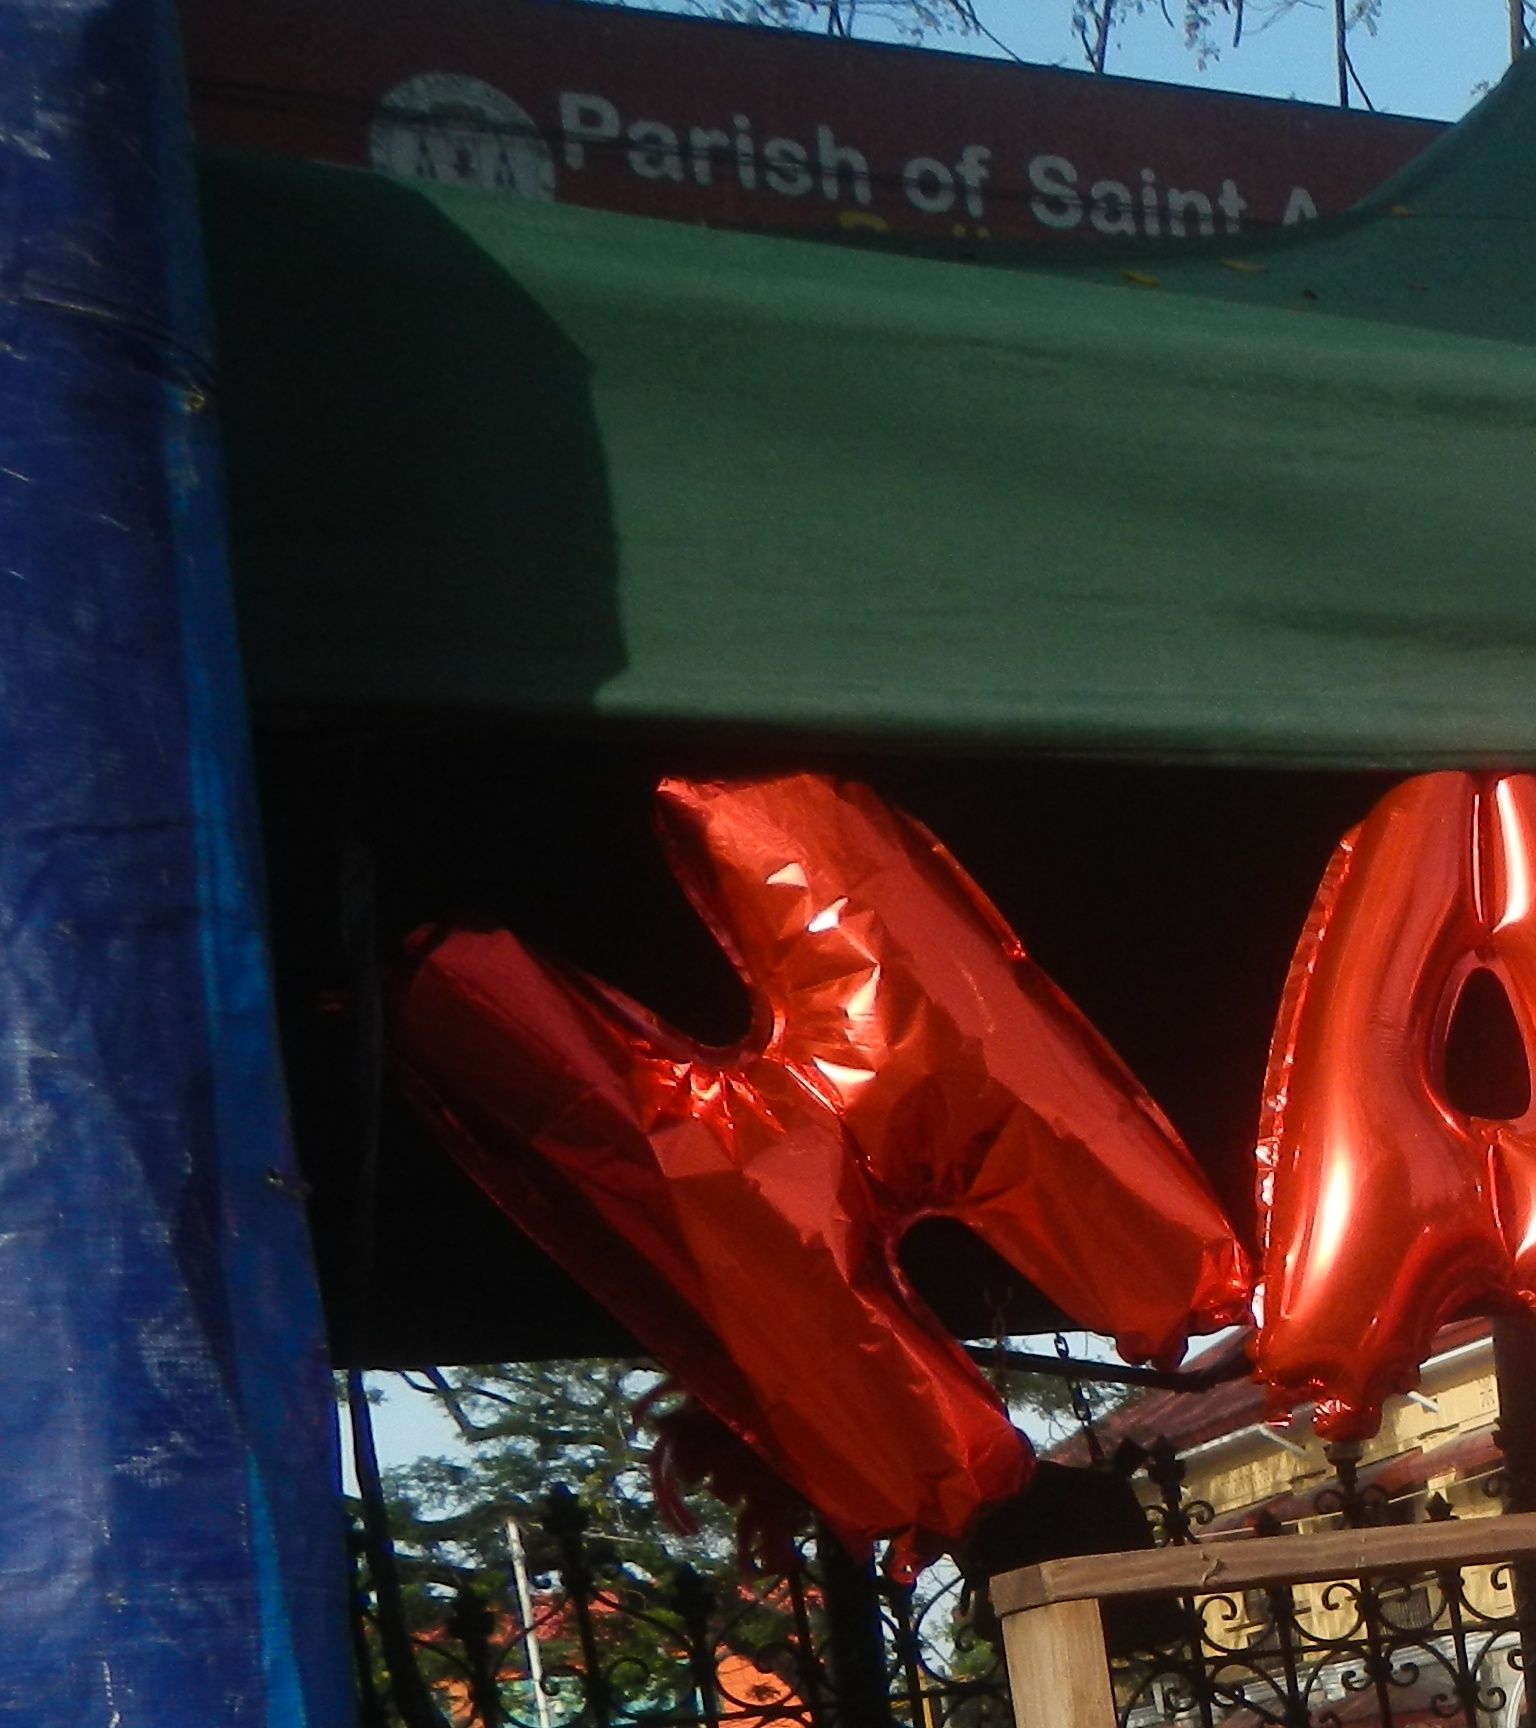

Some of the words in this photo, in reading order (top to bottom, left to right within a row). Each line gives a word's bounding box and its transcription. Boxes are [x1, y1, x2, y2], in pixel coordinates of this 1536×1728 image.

[559, 91, 871, 205] Parish
[901, 143, 993, 219] of
[1027, 154, 1249, 239] Saint
